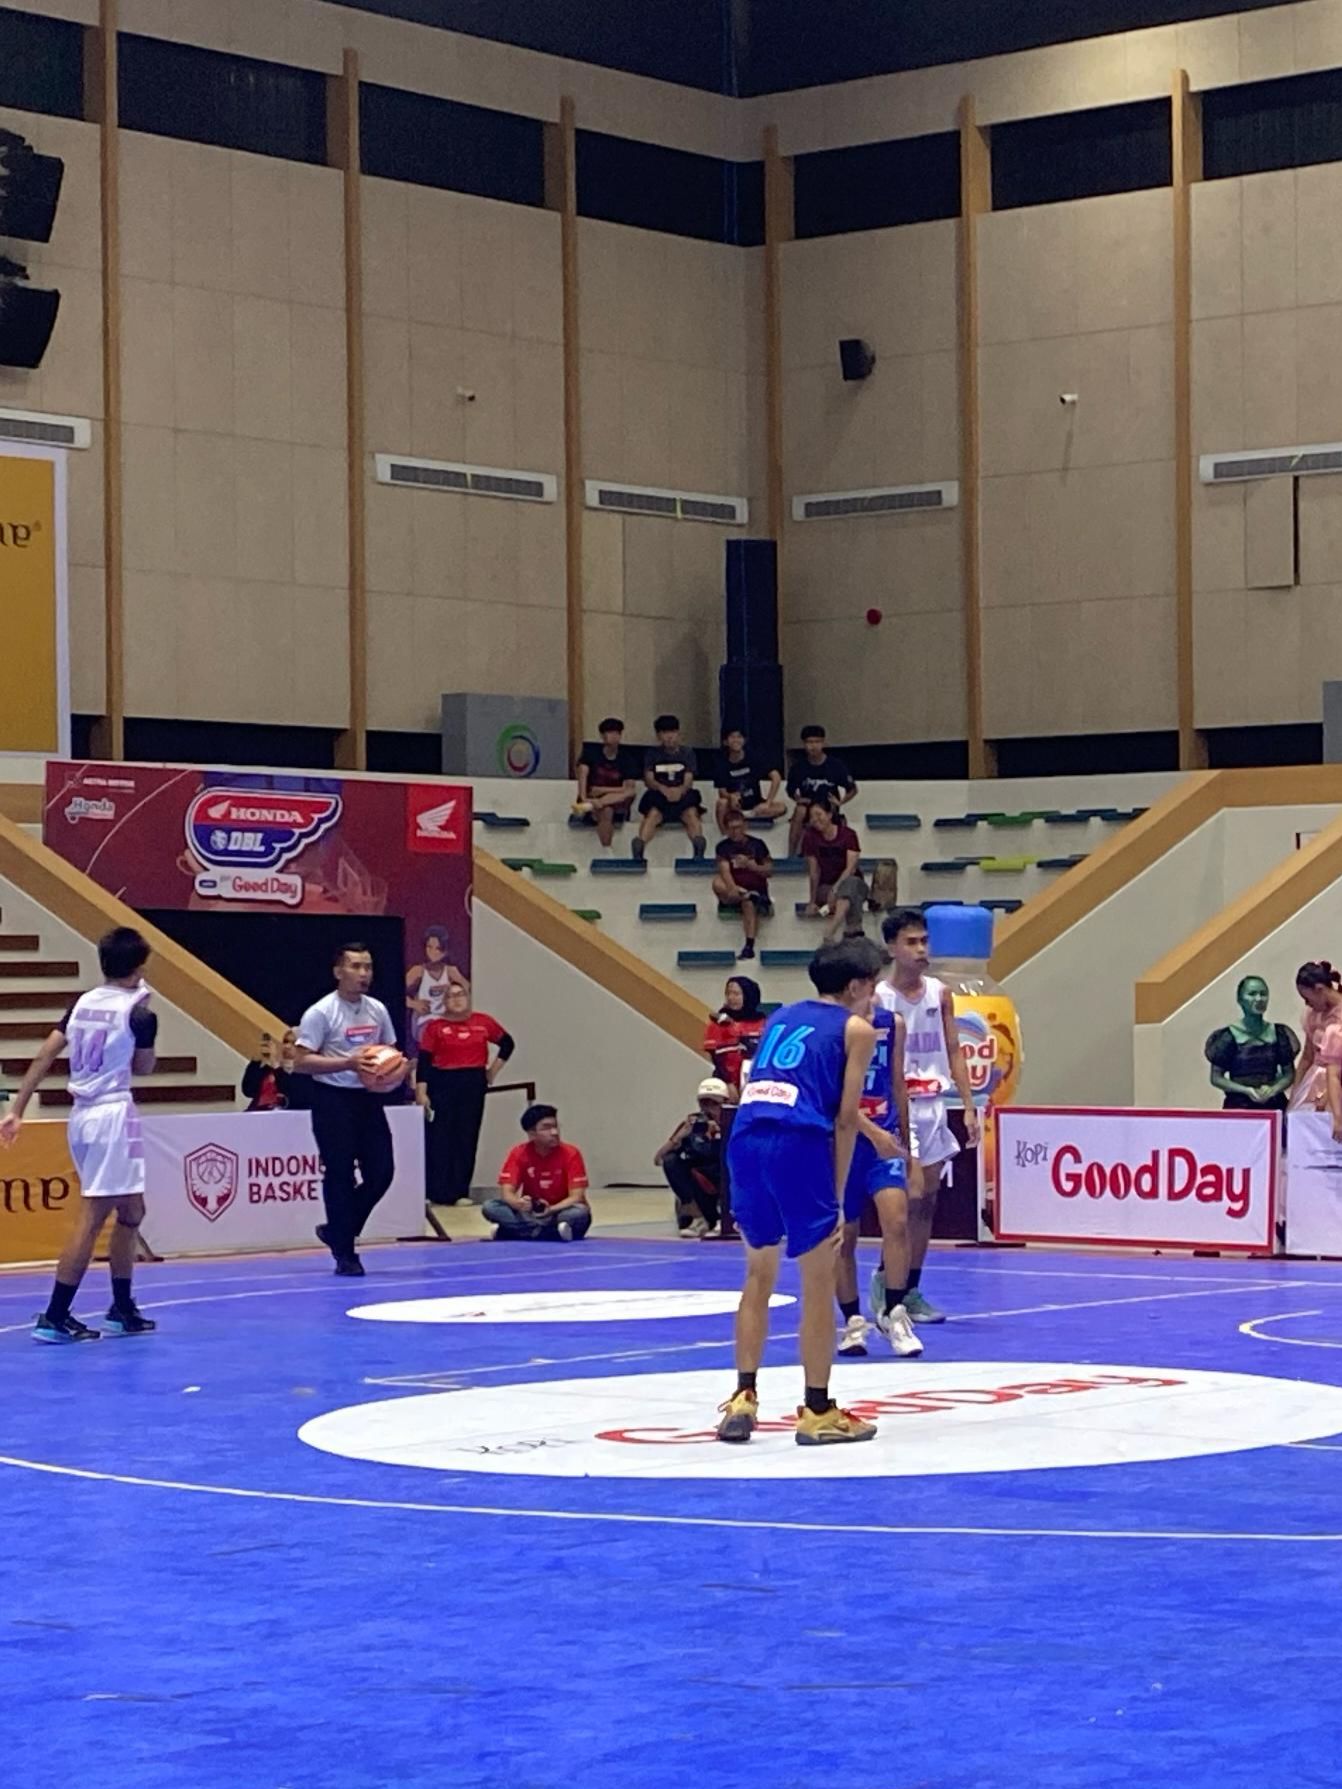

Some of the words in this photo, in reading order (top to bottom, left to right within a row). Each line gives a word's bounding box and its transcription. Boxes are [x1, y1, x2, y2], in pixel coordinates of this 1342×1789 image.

[230, 806, 304, 823] HONDA
[227, 831, 266, 852] DBL
[757, 1023, 816, 1070] 16
[1052, 1144, 1160, 1200] Good
[1167, 1147, 1251, 1219] Day
